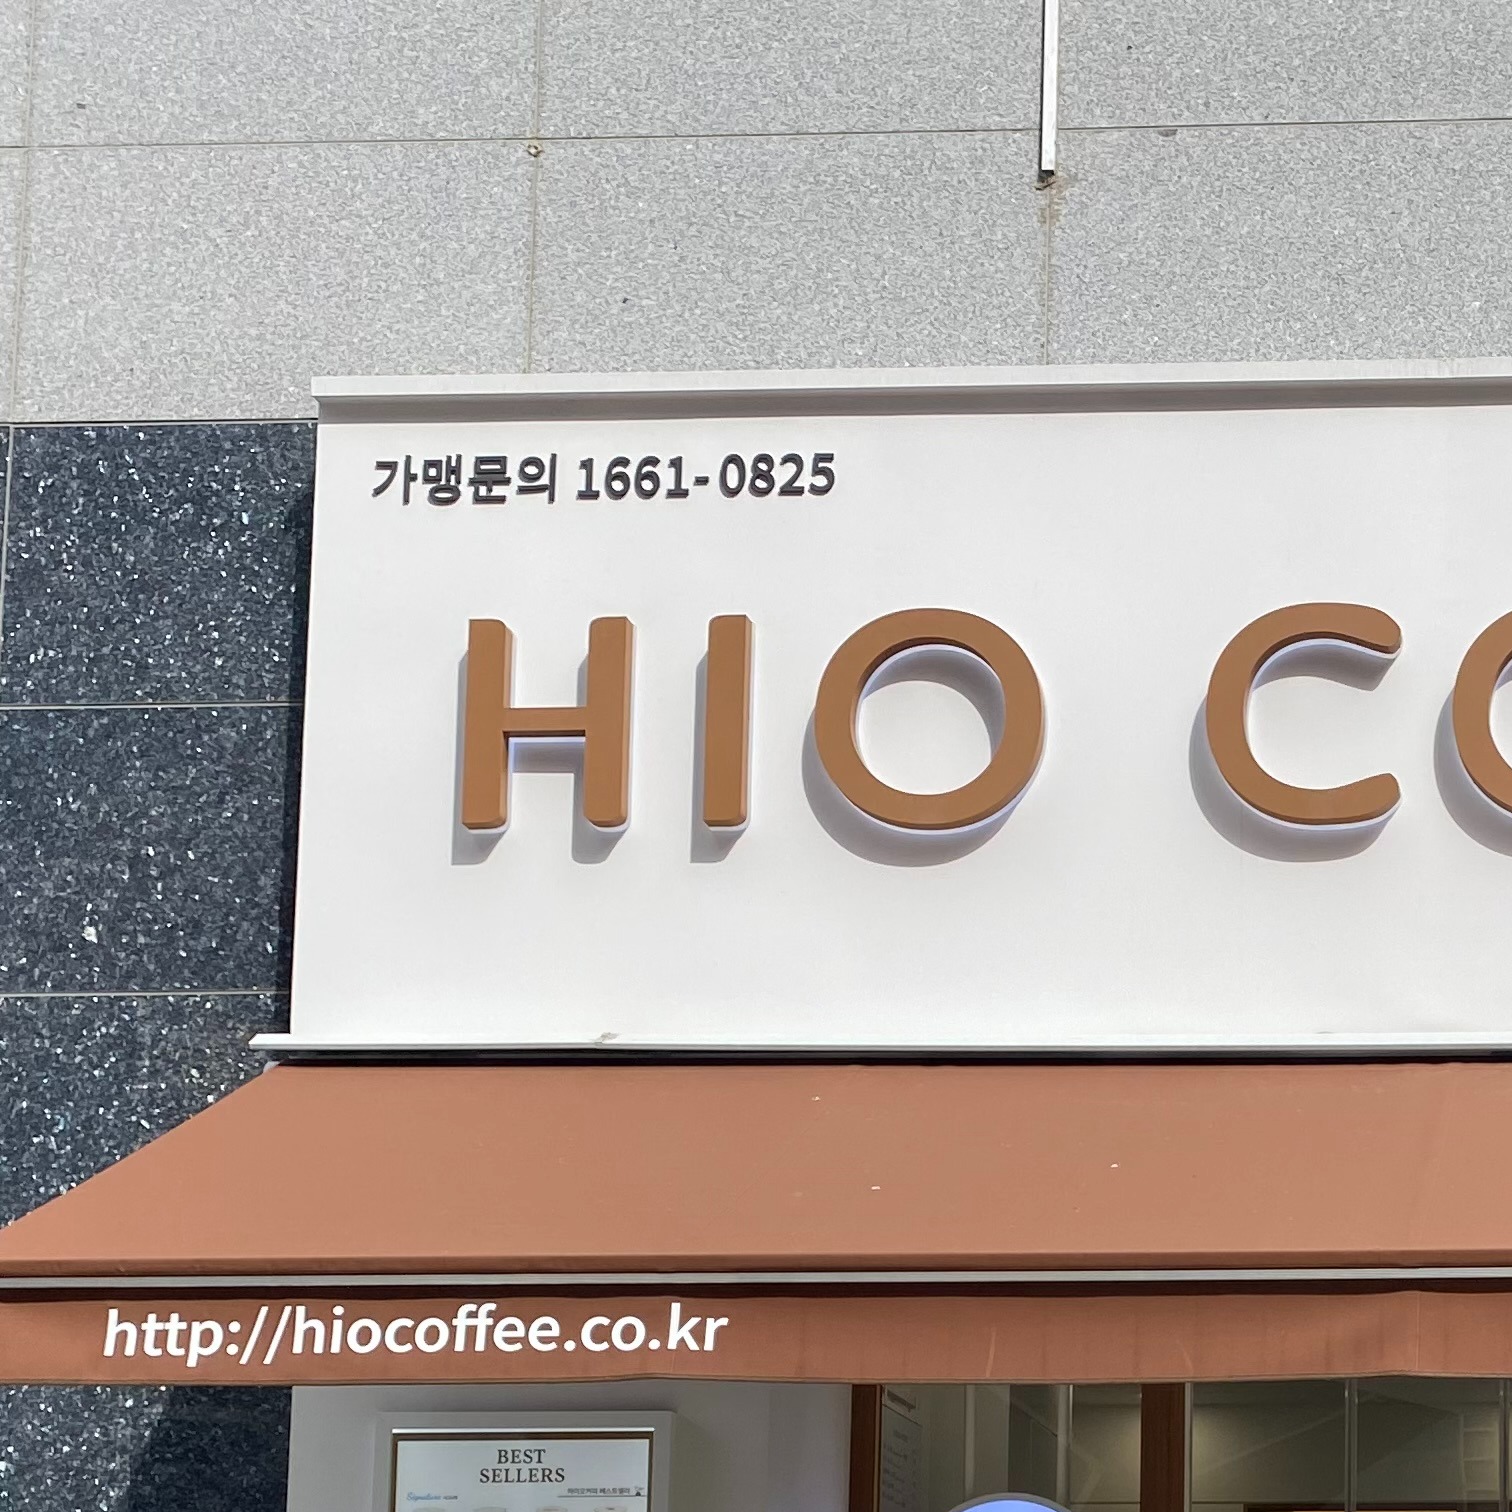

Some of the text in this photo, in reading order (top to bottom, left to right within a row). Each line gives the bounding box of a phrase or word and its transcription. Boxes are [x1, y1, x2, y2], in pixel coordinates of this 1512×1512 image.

[371, 451, 837, 506] 가맹문의 1661-0825
[460, 607, 1045, 831] HIO
[103, 1302, 729, 1368] http://hiocoffee.co.kr
[479, 1467, 566, 1484] SELLERS
[496, 1448, 546, 1465] BEST
